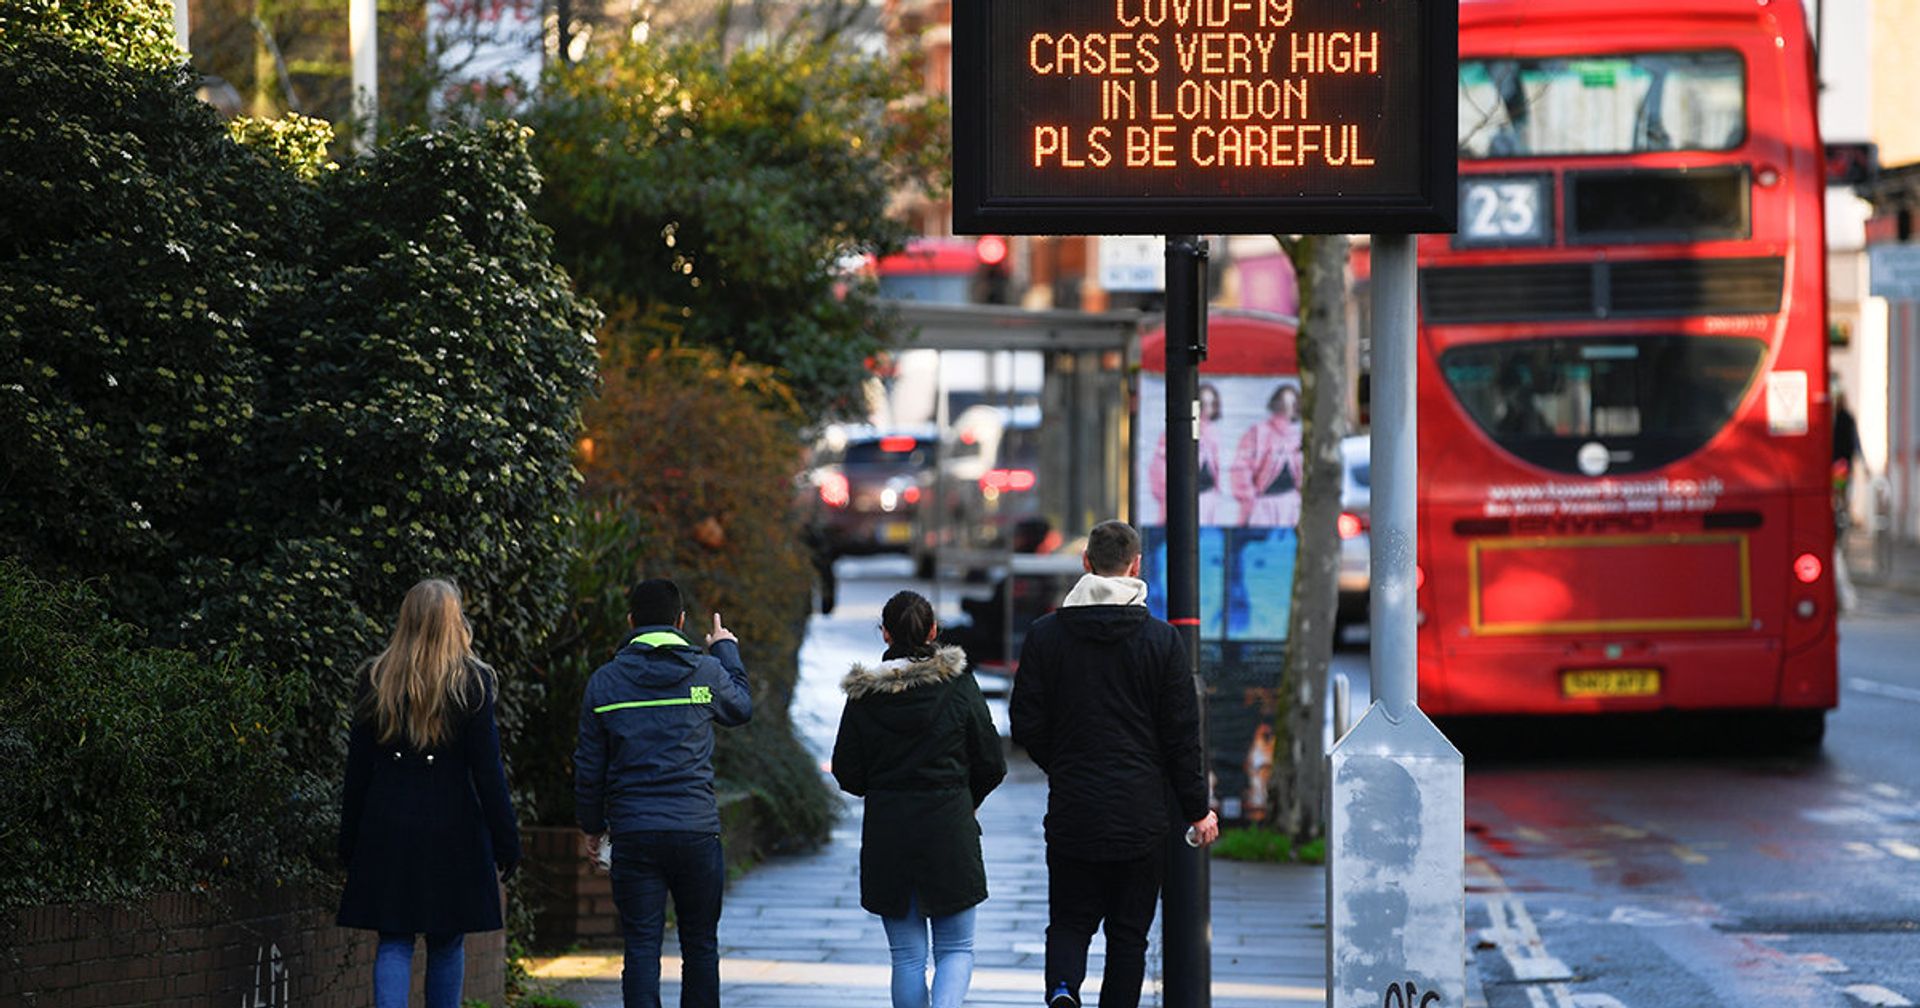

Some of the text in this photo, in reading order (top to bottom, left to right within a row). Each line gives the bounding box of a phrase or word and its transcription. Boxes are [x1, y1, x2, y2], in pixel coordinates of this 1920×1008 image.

[1116, 0, 1293, 28] COVID-19
[1030, 31, 1378, 75] CASES VERY HIGH
[1102, 78, 1308, 121] IN LONDON
[1034, 124, 1375, 168] PLS BE CAREFUL
[1472, 184, 1536, 236] 23
